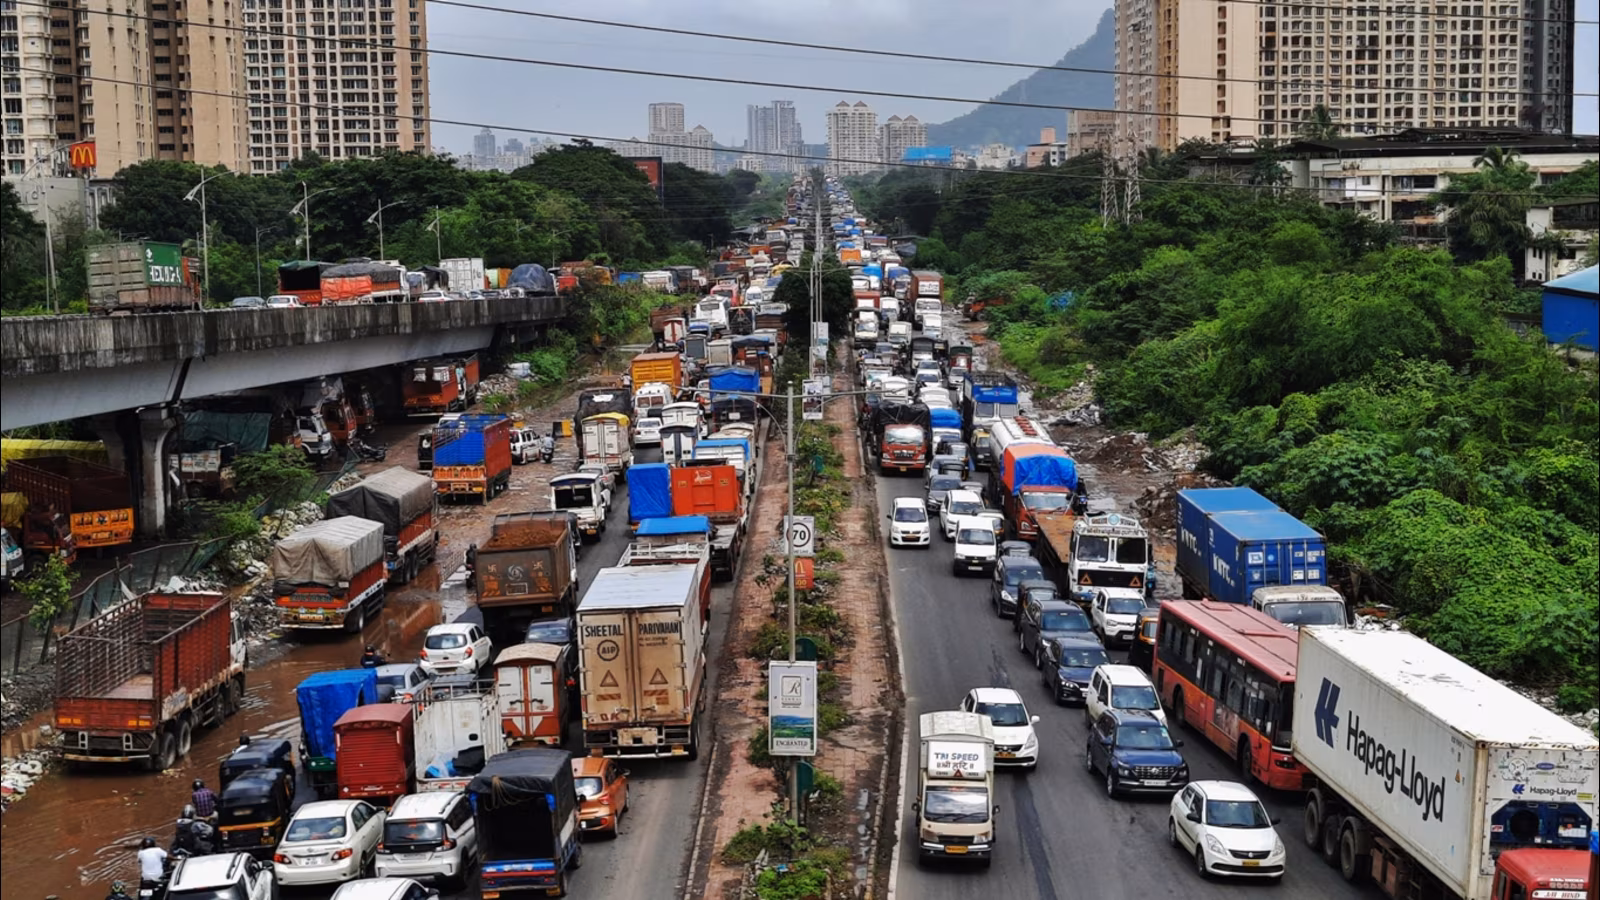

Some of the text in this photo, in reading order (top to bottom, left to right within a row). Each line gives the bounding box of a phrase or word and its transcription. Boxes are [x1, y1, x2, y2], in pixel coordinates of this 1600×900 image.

[793, 530, 806, 540] 70
[585, 621, 679, 637] SHEETAL PARIVAHAN
[934, 752, 979, 762] TRI SPEED
[1346, 710, 1446, 822] Hapag-Lloyd
[1529, 785, 1578, 796] Hapag-Lloyd
